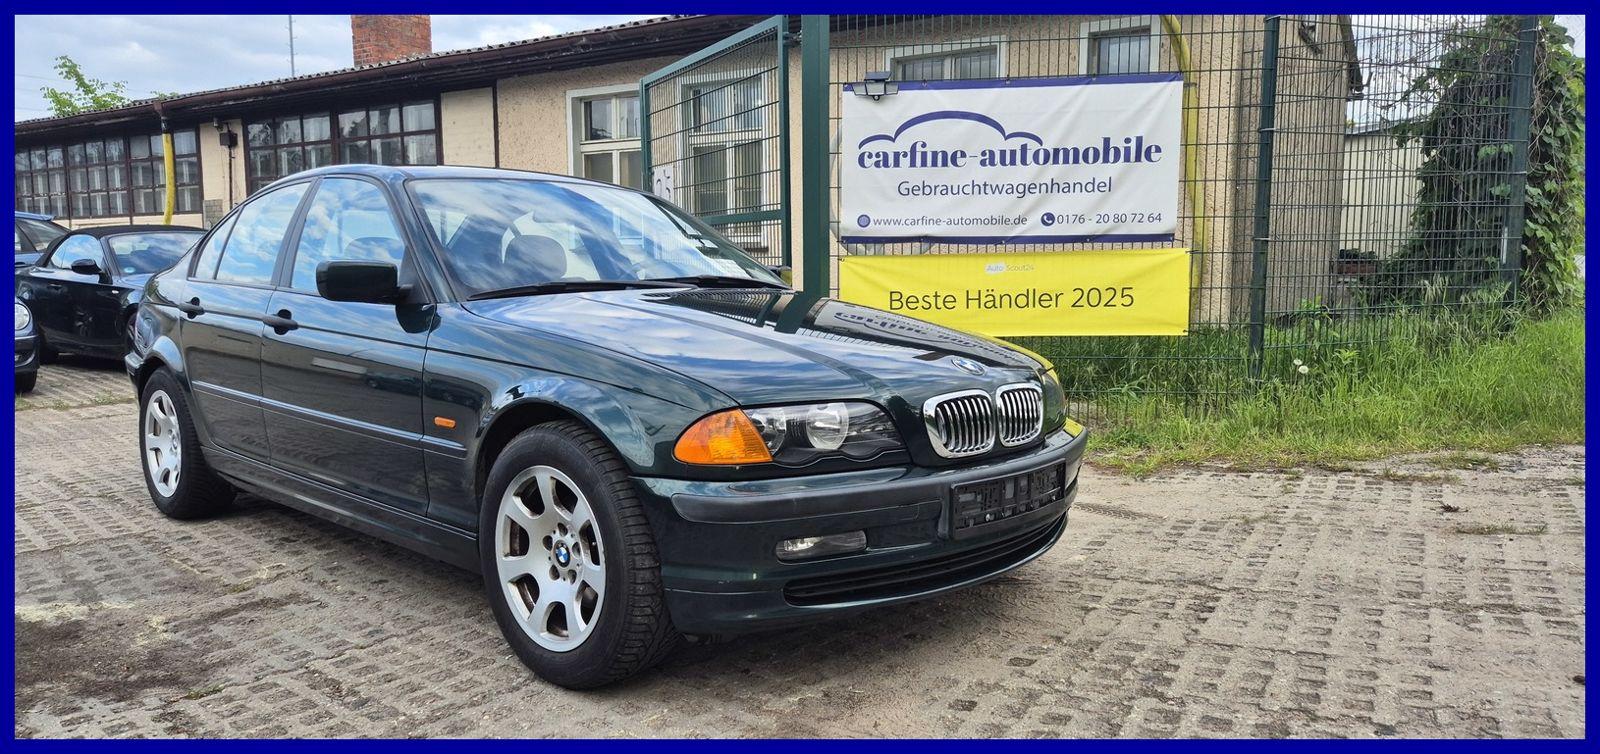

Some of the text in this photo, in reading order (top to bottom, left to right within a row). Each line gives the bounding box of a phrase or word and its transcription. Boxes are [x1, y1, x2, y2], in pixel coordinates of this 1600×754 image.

[858, 136, 1162, 169] carfine-automobile
[897, 177, 1112, 199] Gebrauchtwagenhandel
[873, 214, 1028, 228] www.carfine-automobile.de
[1056, 214, 1085, 225] 0176
[1095, 213, 1111, 224] 20
[1113, 213, 1128, 224] 80
[1130, 213, 1146, 224] 72
[1147, 212, 1162, 223] 64
[889, 287, 1135, 311] Beste Händler 2025
